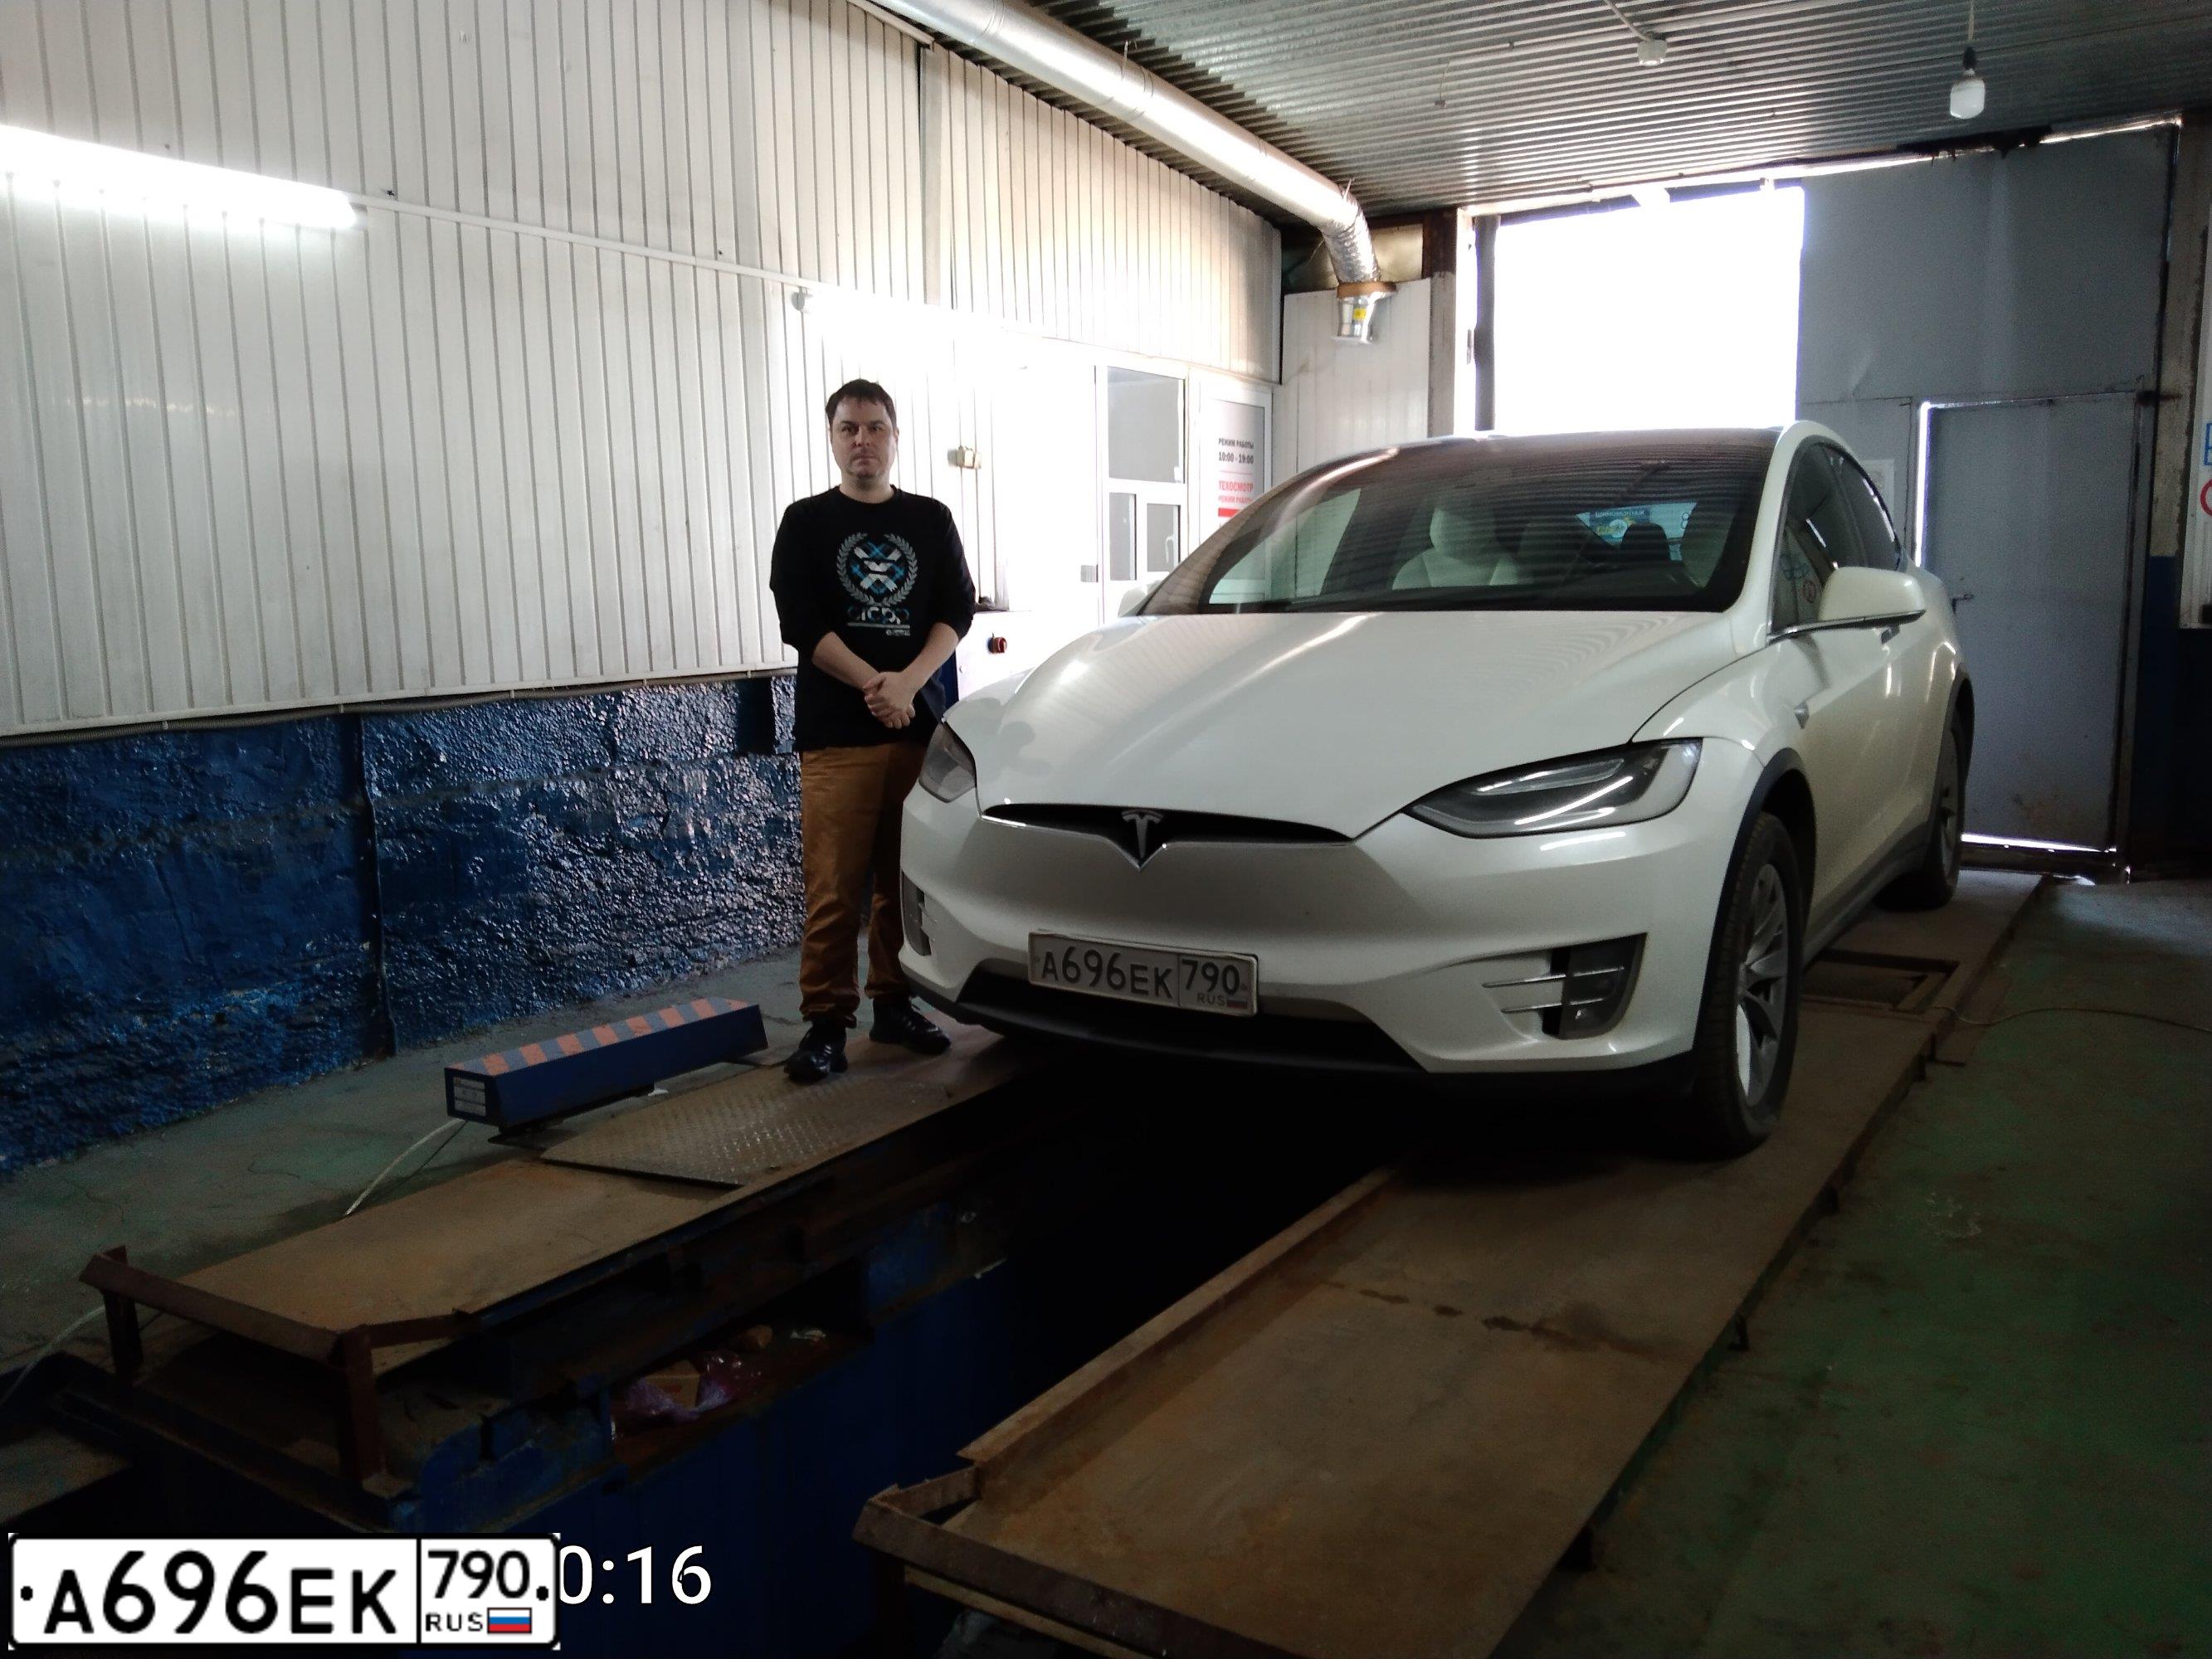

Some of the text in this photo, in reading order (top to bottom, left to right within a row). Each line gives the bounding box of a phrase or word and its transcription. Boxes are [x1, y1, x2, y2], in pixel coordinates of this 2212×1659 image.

[1218, 438, 1255, 449] РЕЖИМ РАБОТЫ
[1218, 451, 1235, 462] 10:00
[1239, 454, 1255, 465] 19:00
[1218, 480, 1254, 493] ТЕХОСМОТР
[1182, 959, 1240, 995] 790
[1196, 993, 1226, 1007] RUS
